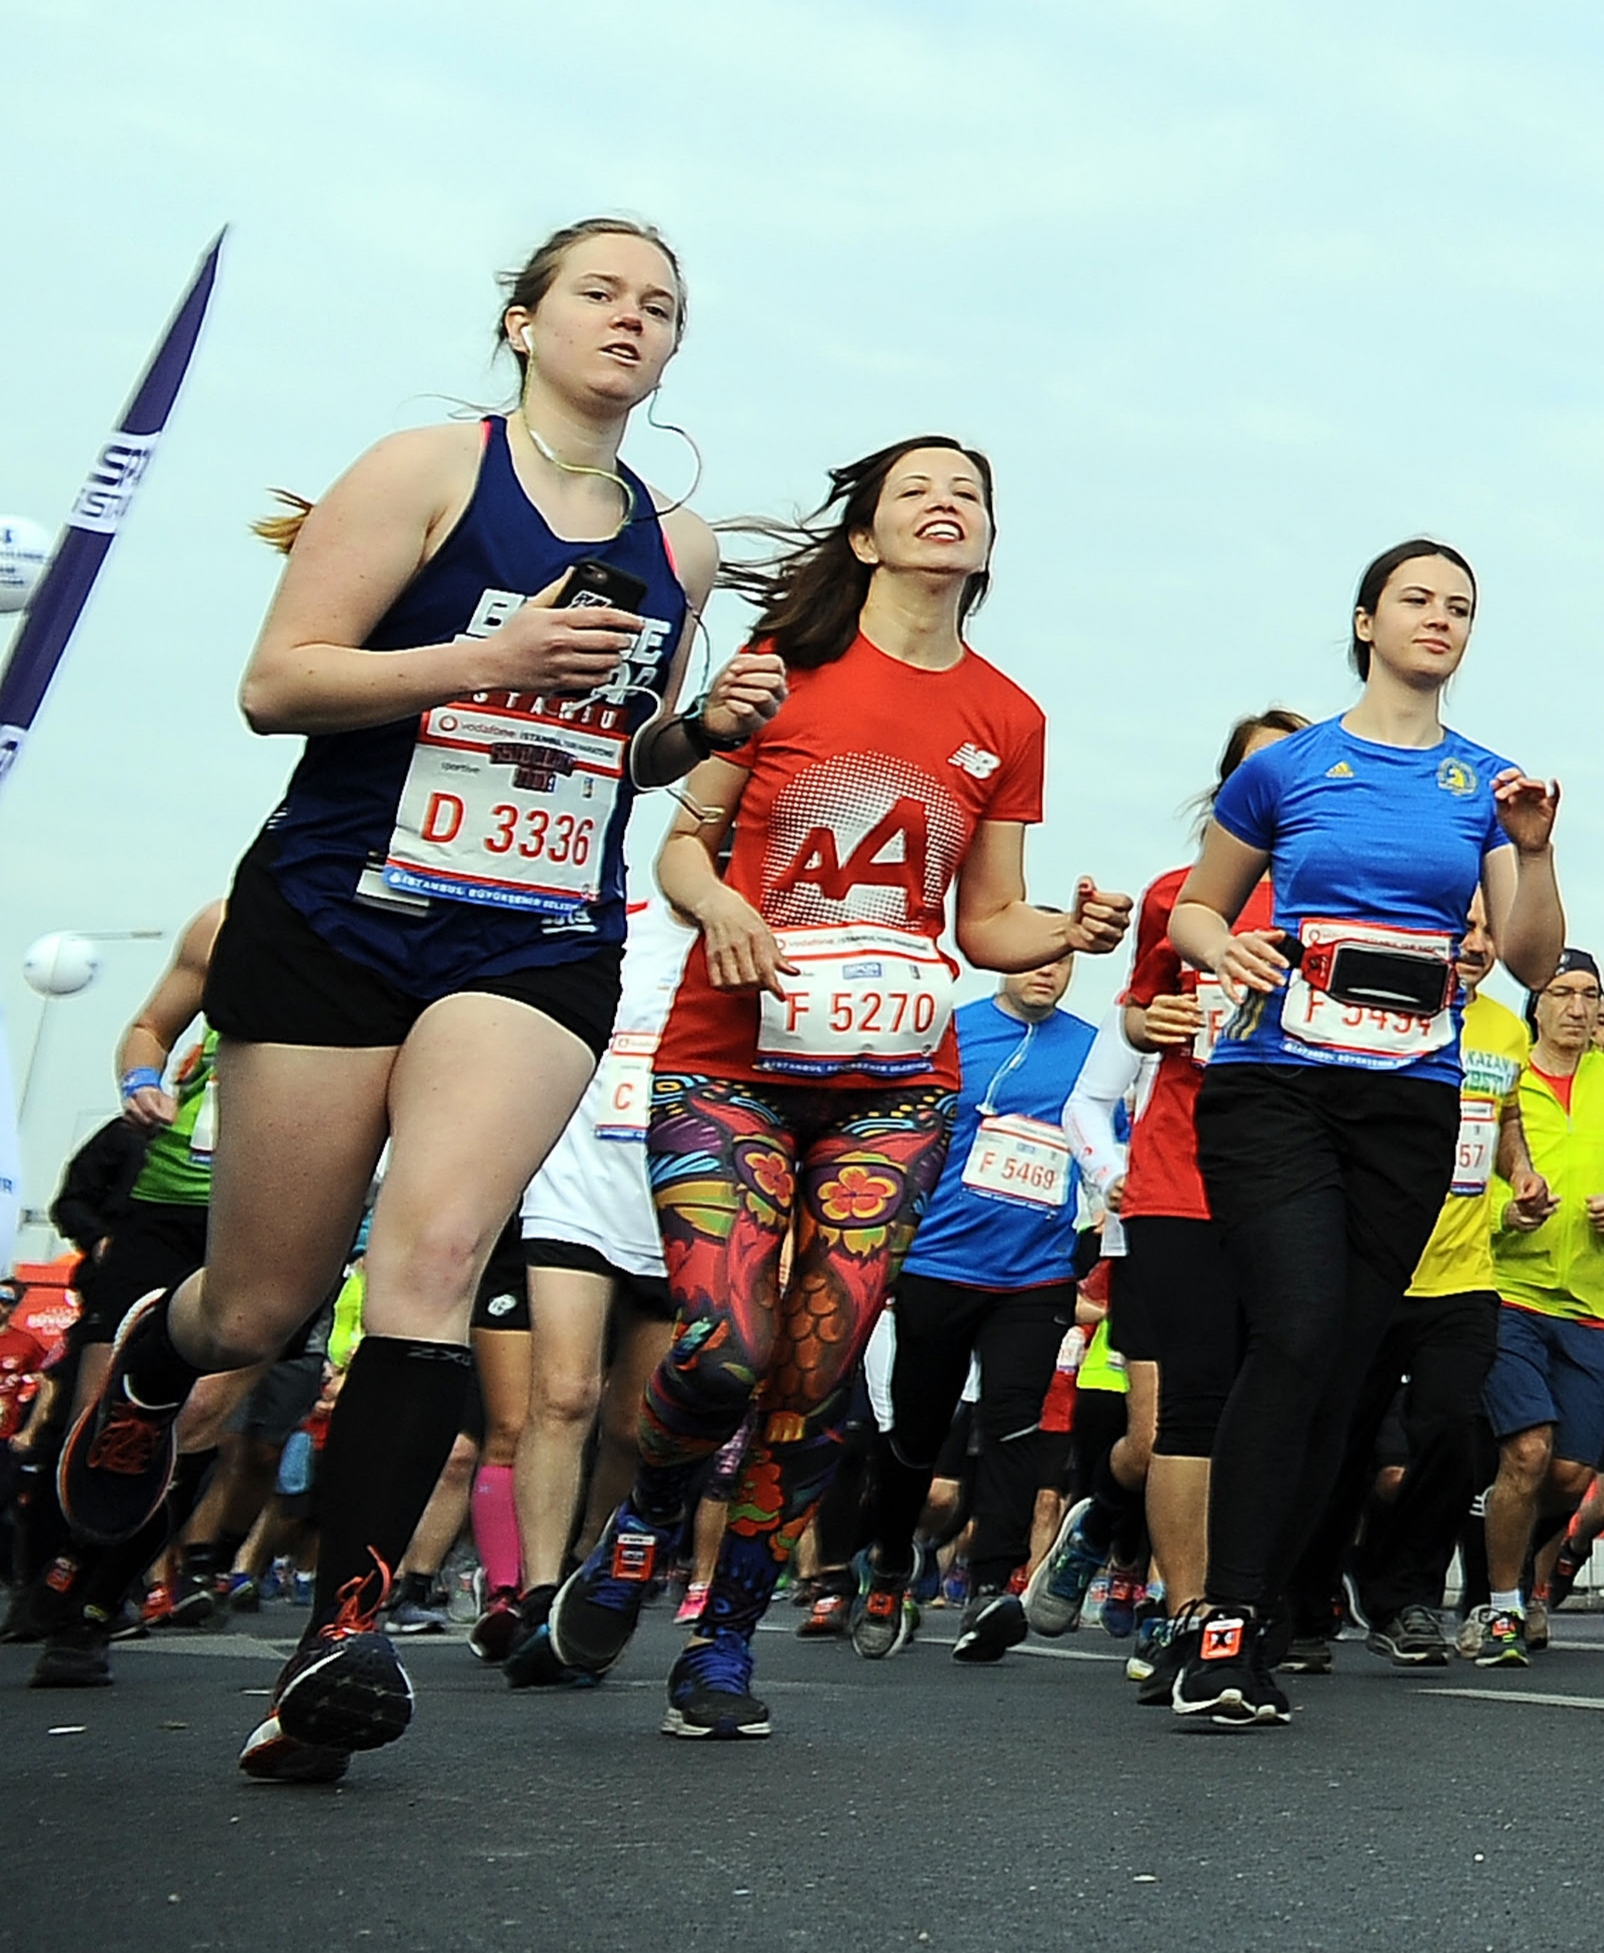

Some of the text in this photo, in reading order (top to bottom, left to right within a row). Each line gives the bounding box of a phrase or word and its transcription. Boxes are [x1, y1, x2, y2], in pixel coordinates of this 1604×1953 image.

[421, 792, 594, 866] D 3336
[786, 992, 935, 1033] F 5270
[614, 1083, 634, 1110] C
[979, 1151, 1056, 1189] F 5469
